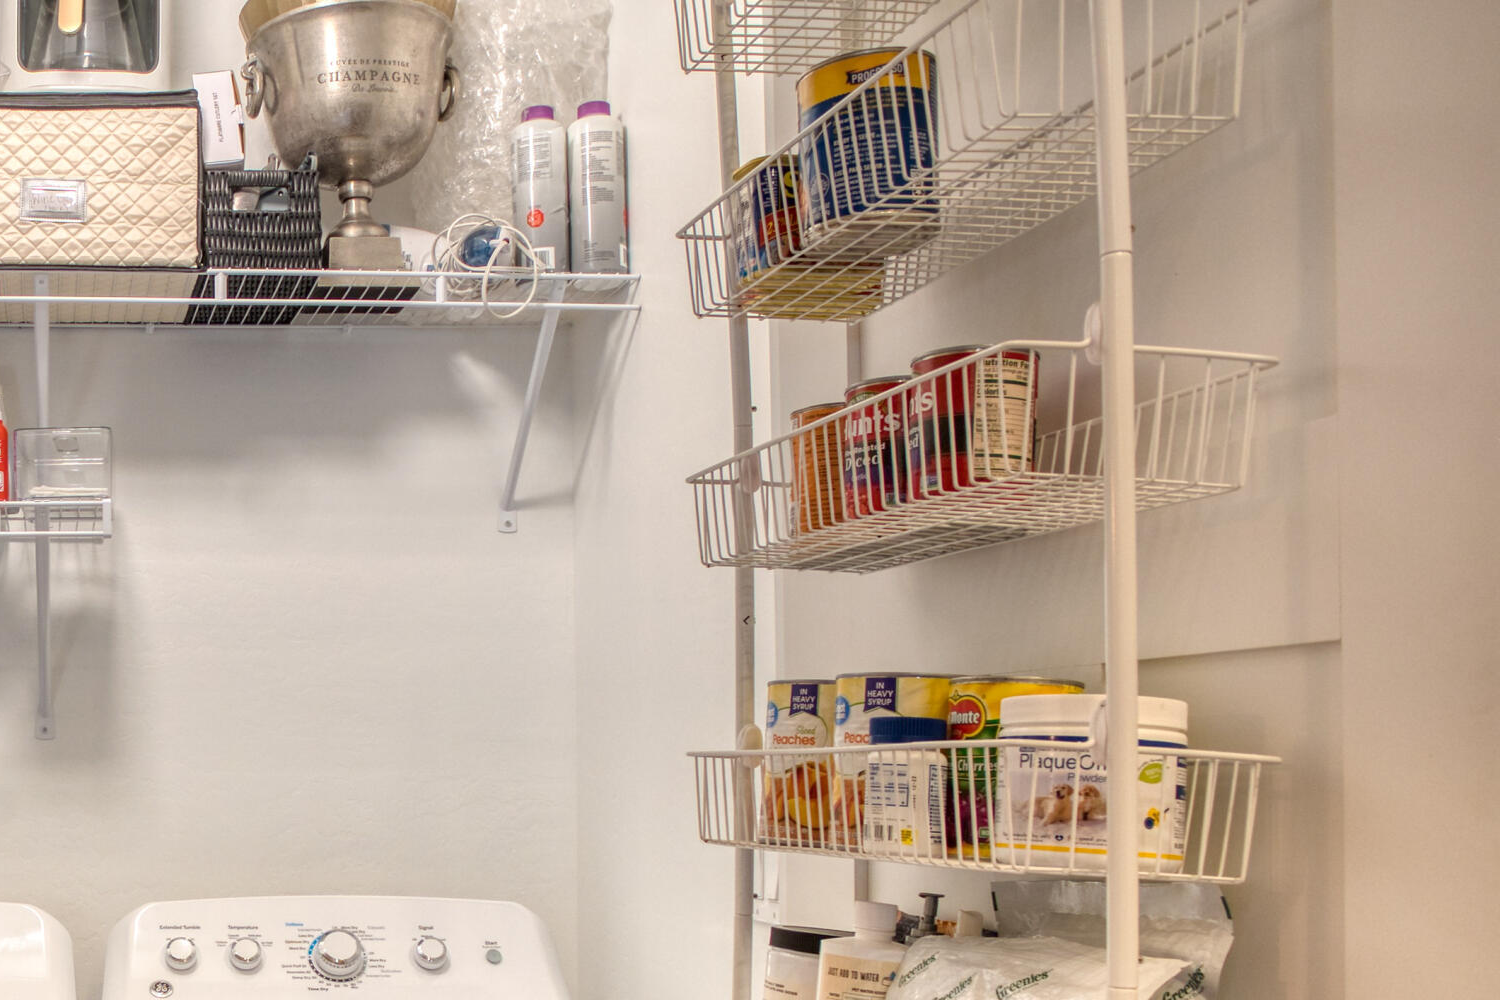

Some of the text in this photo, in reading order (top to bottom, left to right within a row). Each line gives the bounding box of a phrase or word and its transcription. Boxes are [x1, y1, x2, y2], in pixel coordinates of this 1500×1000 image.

[317, 69, 421, 86] CHAMPAGNE
[851, 62, 903, 84] PROGSO
[875, 681, 885, 689] IN
[867, 690, 894, 698] HEAVY
[792, 696, 816, 704] HEAVY
[867, 698, 893, 706] SYRUP
[792, 703, 815, 711] SYRUP
[772, 734, 816, 746] Peaches
[860, 971, 879, 982] WATER
[995, 969, 1050, 1000] Greenies
